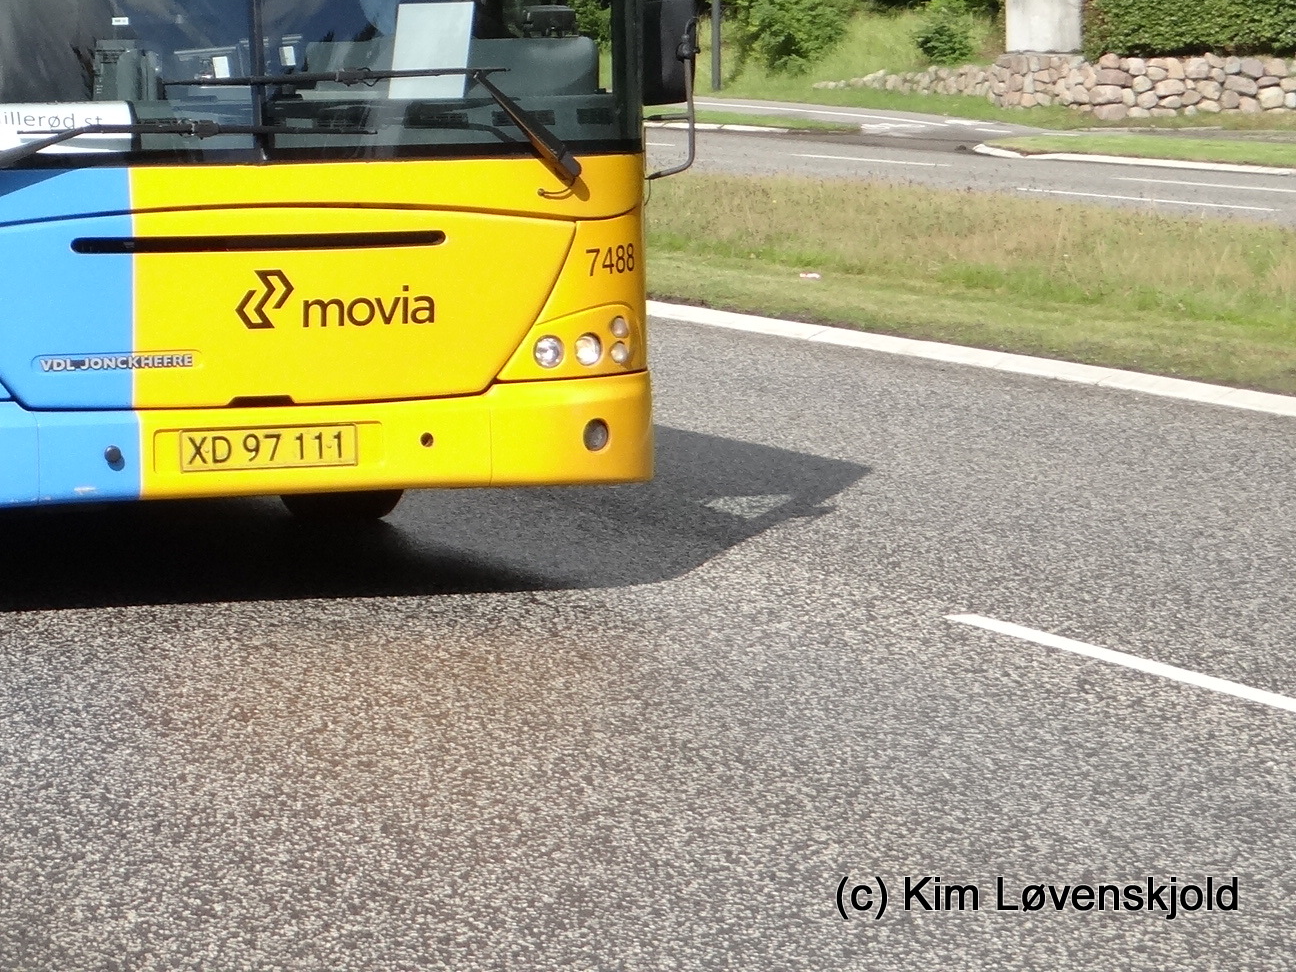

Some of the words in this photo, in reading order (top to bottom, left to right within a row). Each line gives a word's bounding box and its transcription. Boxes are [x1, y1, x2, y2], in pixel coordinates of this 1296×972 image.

[586, 243, 636, 277] 7488
[303, 285, 435, 327] movia
[39, 357, 75, 372] VDL
[80, 354, 193, 370] JONCKHEERE
[187, 436, 232, 466] XD
[241, 433, 282, 462] 97
[294, 430, 344, 461] 111
